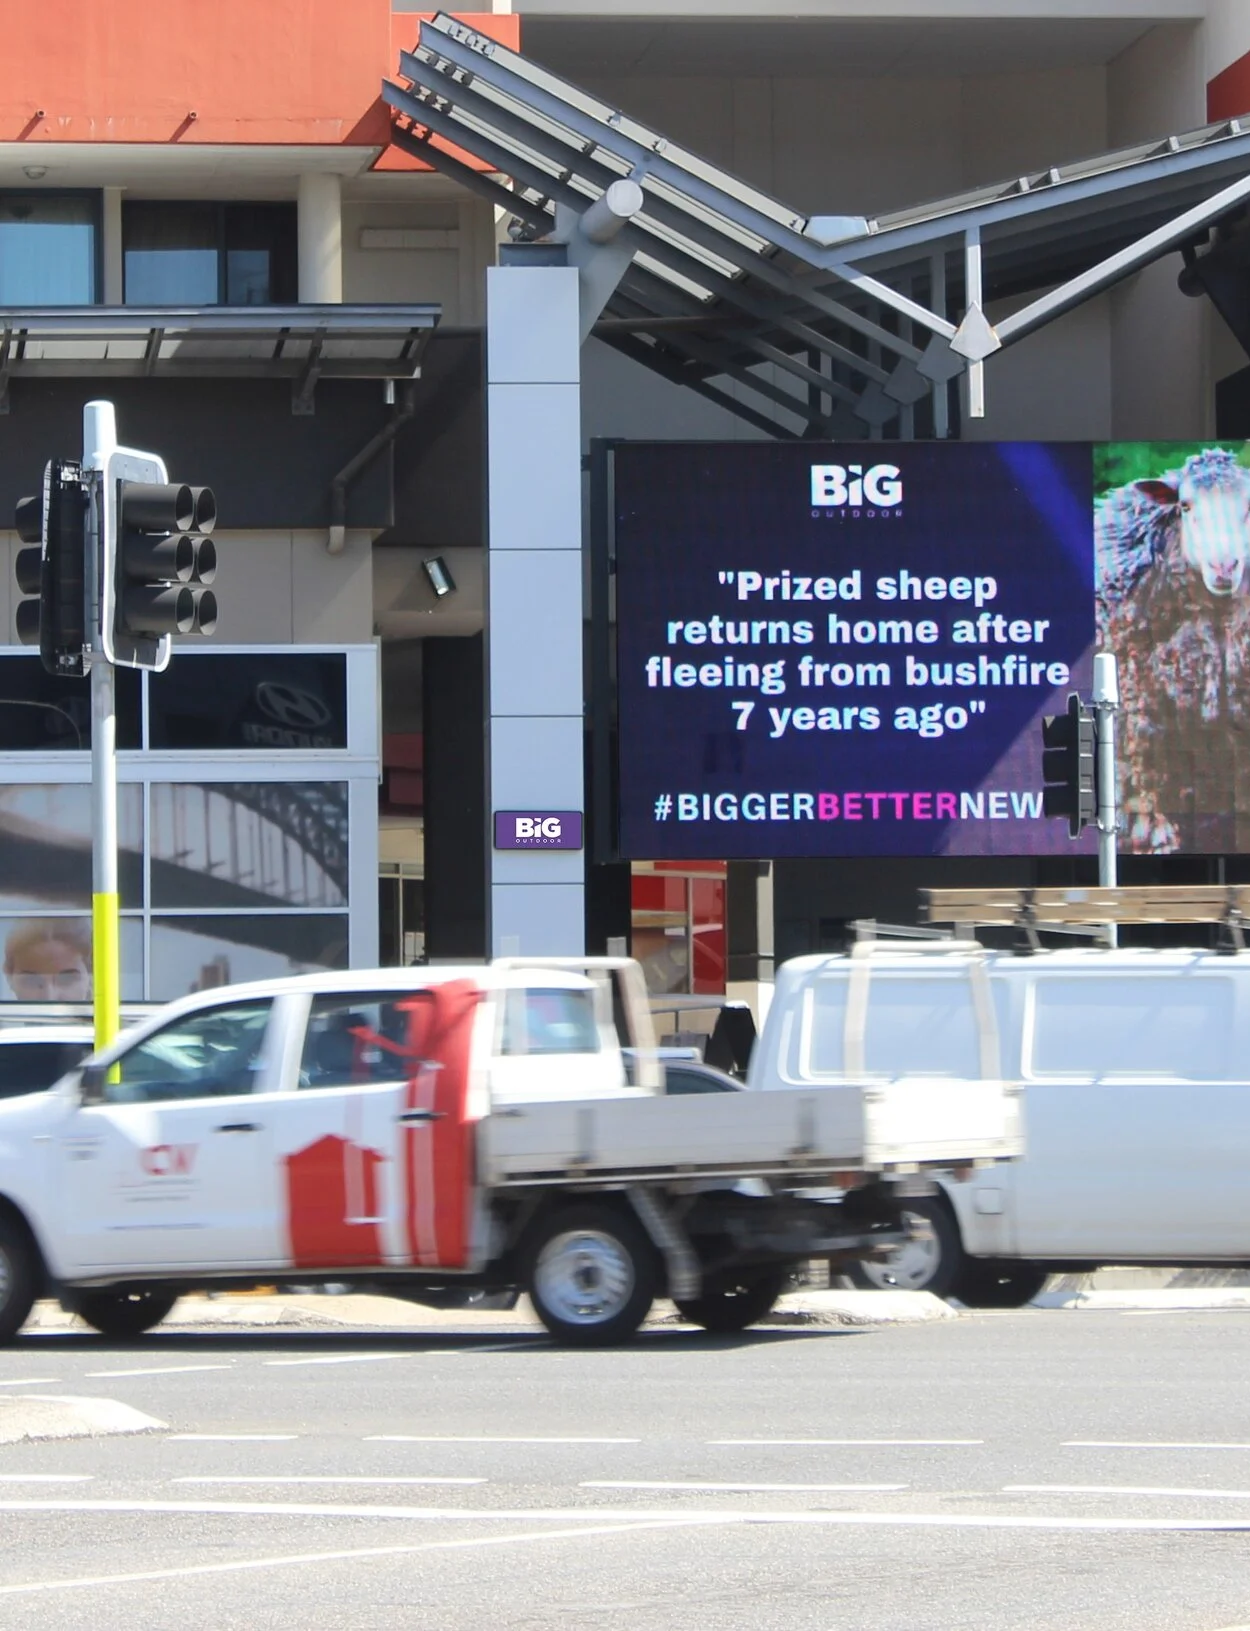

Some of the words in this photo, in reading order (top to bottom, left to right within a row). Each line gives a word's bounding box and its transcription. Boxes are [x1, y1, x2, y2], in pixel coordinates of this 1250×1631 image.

[811, 508, 903, 518] OUTDOOR
[719, 570, 862, 601] "Prized
[875, 570, 998, 607] sheep
[668, 615, 814, 644] returns
[828, 614, 939, 644] home
[952, 611, 1050, 644] after
[645, 656, 787, 695] fleeing
[798, 656, 891, 688] from
[906, 655, 1070, 688] bushfire
[731, 700, 756, 731] 7
[768, 707, 881, 739] years
[893, 700, 986, 739] ago"
[654, 791, 1043, 822] #BIGGERBETTERNEW
